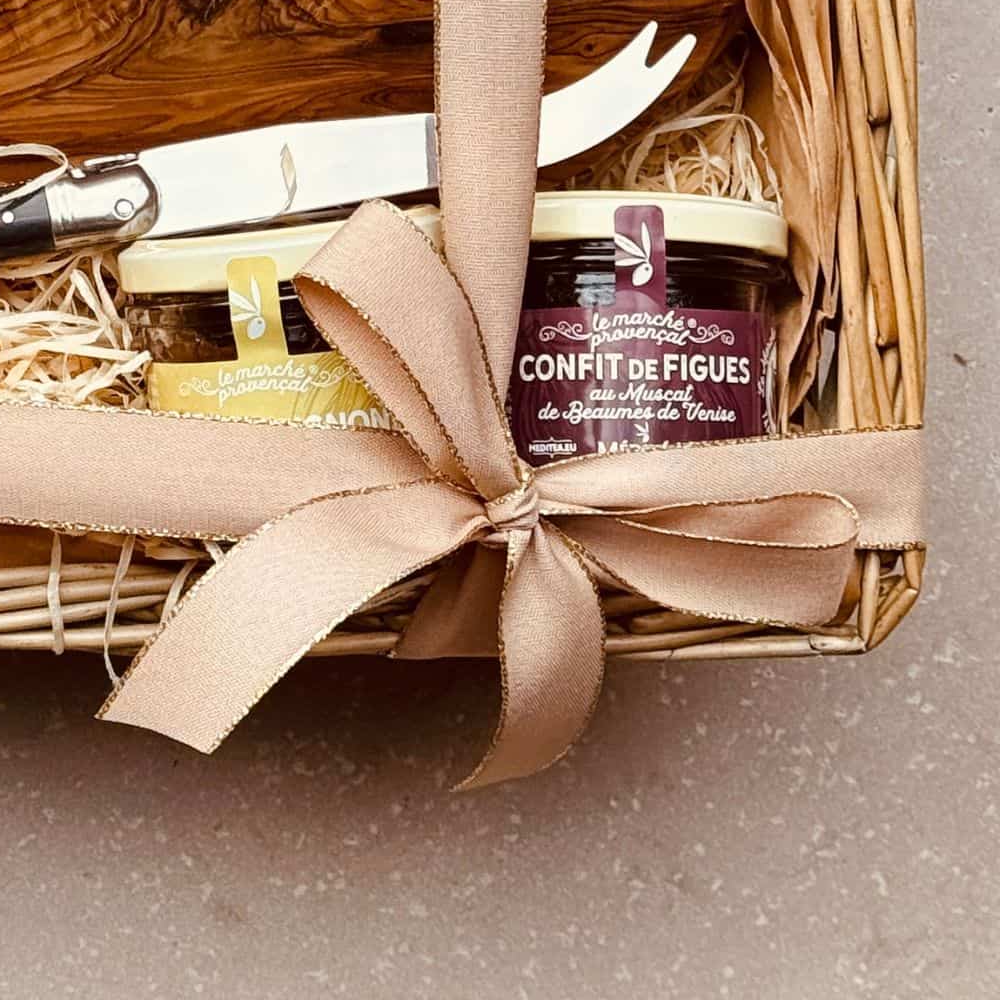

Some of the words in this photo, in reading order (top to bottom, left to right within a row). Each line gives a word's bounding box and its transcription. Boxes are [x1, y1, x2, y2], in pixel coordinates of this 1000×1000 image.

[593, 312, 611, 332] le
[612, 310, 685, 331] marché
[591, 326, 690, 353] provençal
[218, 367, 234, 386] le
[518, 353, 624, 382] CONFIT
[628, 358, 659, 381] DE
[663, 353, 750, 384] FIGUES
[217, 376, 312, 408] provençal
[589, 387, 616, 401] au
[618, 382, 694, 405] Muscat
[537, 403, 560, 421] de
[562, 401, 656, 425] Beaumes
[656, 403, 681, 421] de
[682, 403, 737, 423] Venise
